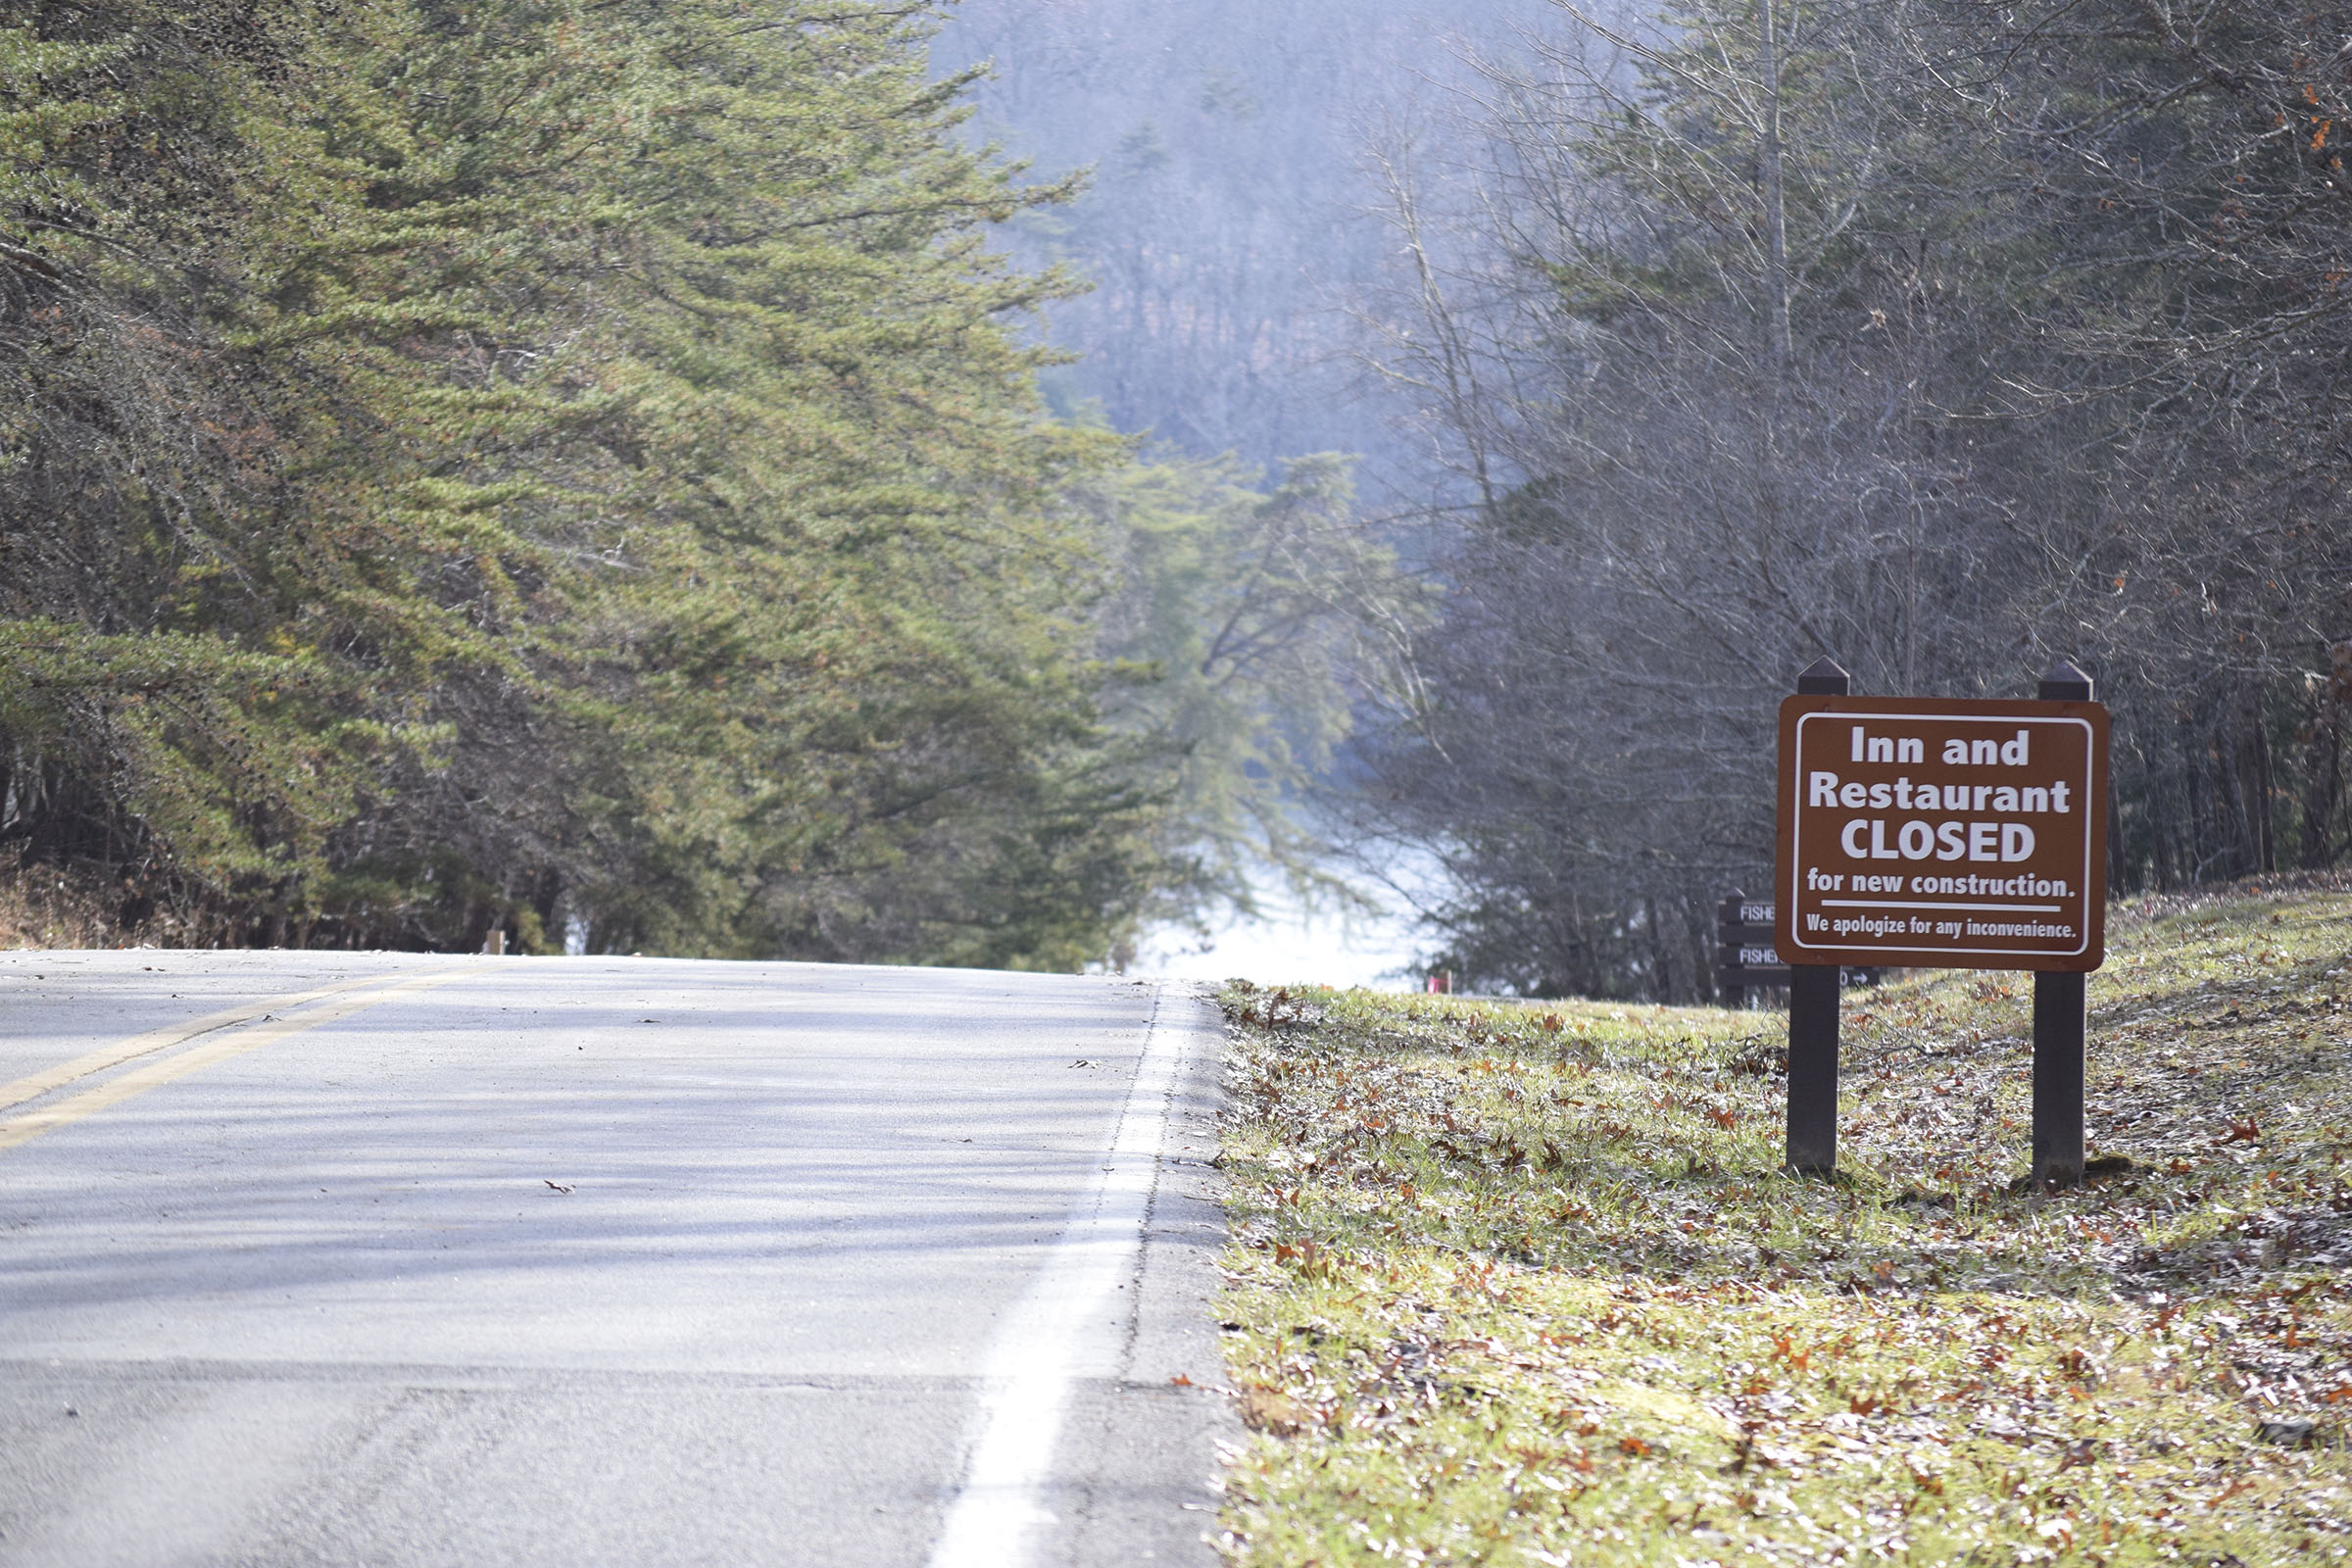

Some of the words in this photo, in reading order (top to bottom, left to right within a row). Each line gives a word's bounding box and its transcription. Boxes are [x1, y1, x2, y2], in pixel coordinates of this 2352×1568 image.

[1852, 727, 1923, 762] Inn
[1942, 730, 2029, 765] and
[1810, 771, 2070, 812] Restaurant
[1841, 819, 2034, 861] CLOSED
[1807, 867, 1843, 891] for
[1852, 875, 1903, 892] new
[1911, 873, 2075, 897] construction.
[1740, 906, 1776, 921] FISHE
[1807, 914, 1828, 931] We
[1834, 915, 1905, 937] apologize
[1910, 916, 1932, 933] for
[1936, 922, 1962, 939] any
[1967, 918, 2076, 937] inconvenience.
[1740, 948, 1785, 964] FISHE
